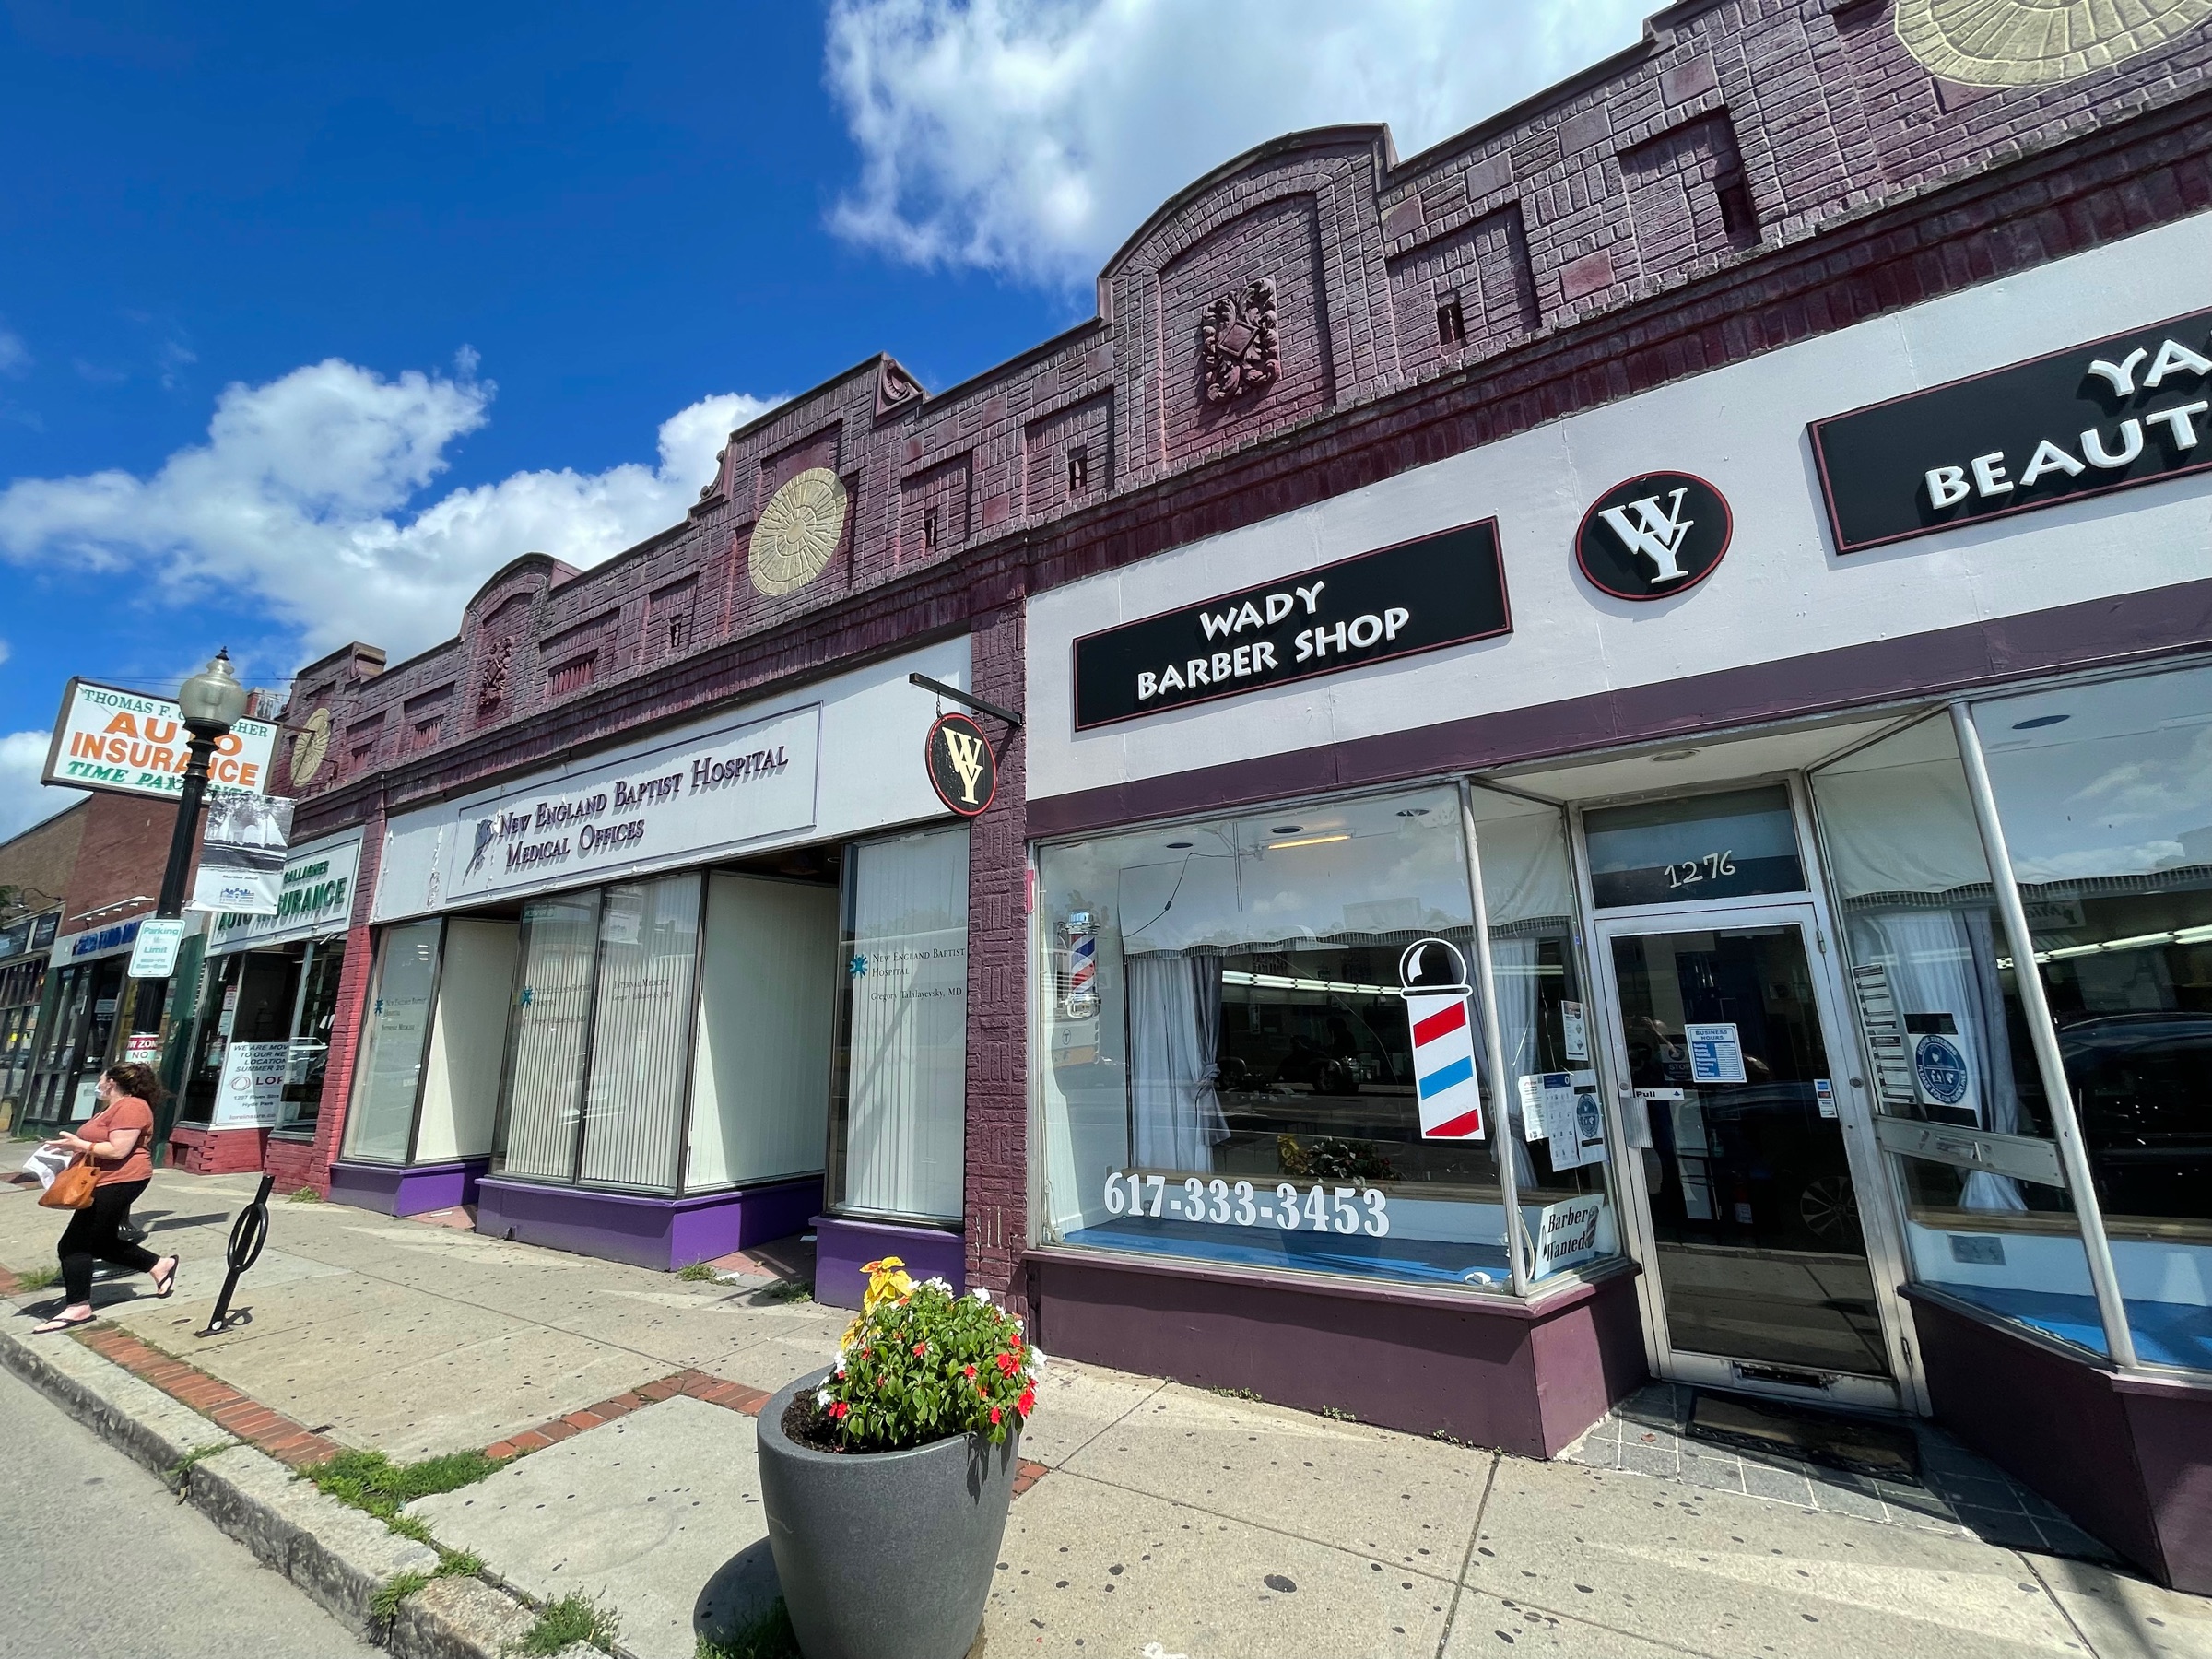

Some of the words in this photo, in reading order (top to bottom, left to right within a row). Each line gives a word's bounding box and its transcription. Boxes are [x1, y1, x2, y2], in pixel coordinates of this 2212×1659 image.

[2087, 330, 2212, 397] YA
[1924, 400, 2209, 510] BEAUT
[1199, 580, 1325, 641] WADY
[1137, 641, 1278, 700] BARBER
[1295, 606, 1410, 664] SHOP
[84, 689, 154, 713] THOMAS
[158, 704, 172, 718] F.
[103, 712, 243, 756] AUO
[65, 761, 129, 782] TIME
[1664, 849, 1736, 888] 1276
[143, 926, 180, 936] Parking
[144, 946, 168, 954] Limit
[871, 992, 898, 1002] Gregory
[947, 987, 962, 996] MD
[131, 1051, 148, 1059] NO
[1103, 1171, 1391, 1238] 617-333-3453
[1547, 1206, 1588, 1233] Barber
